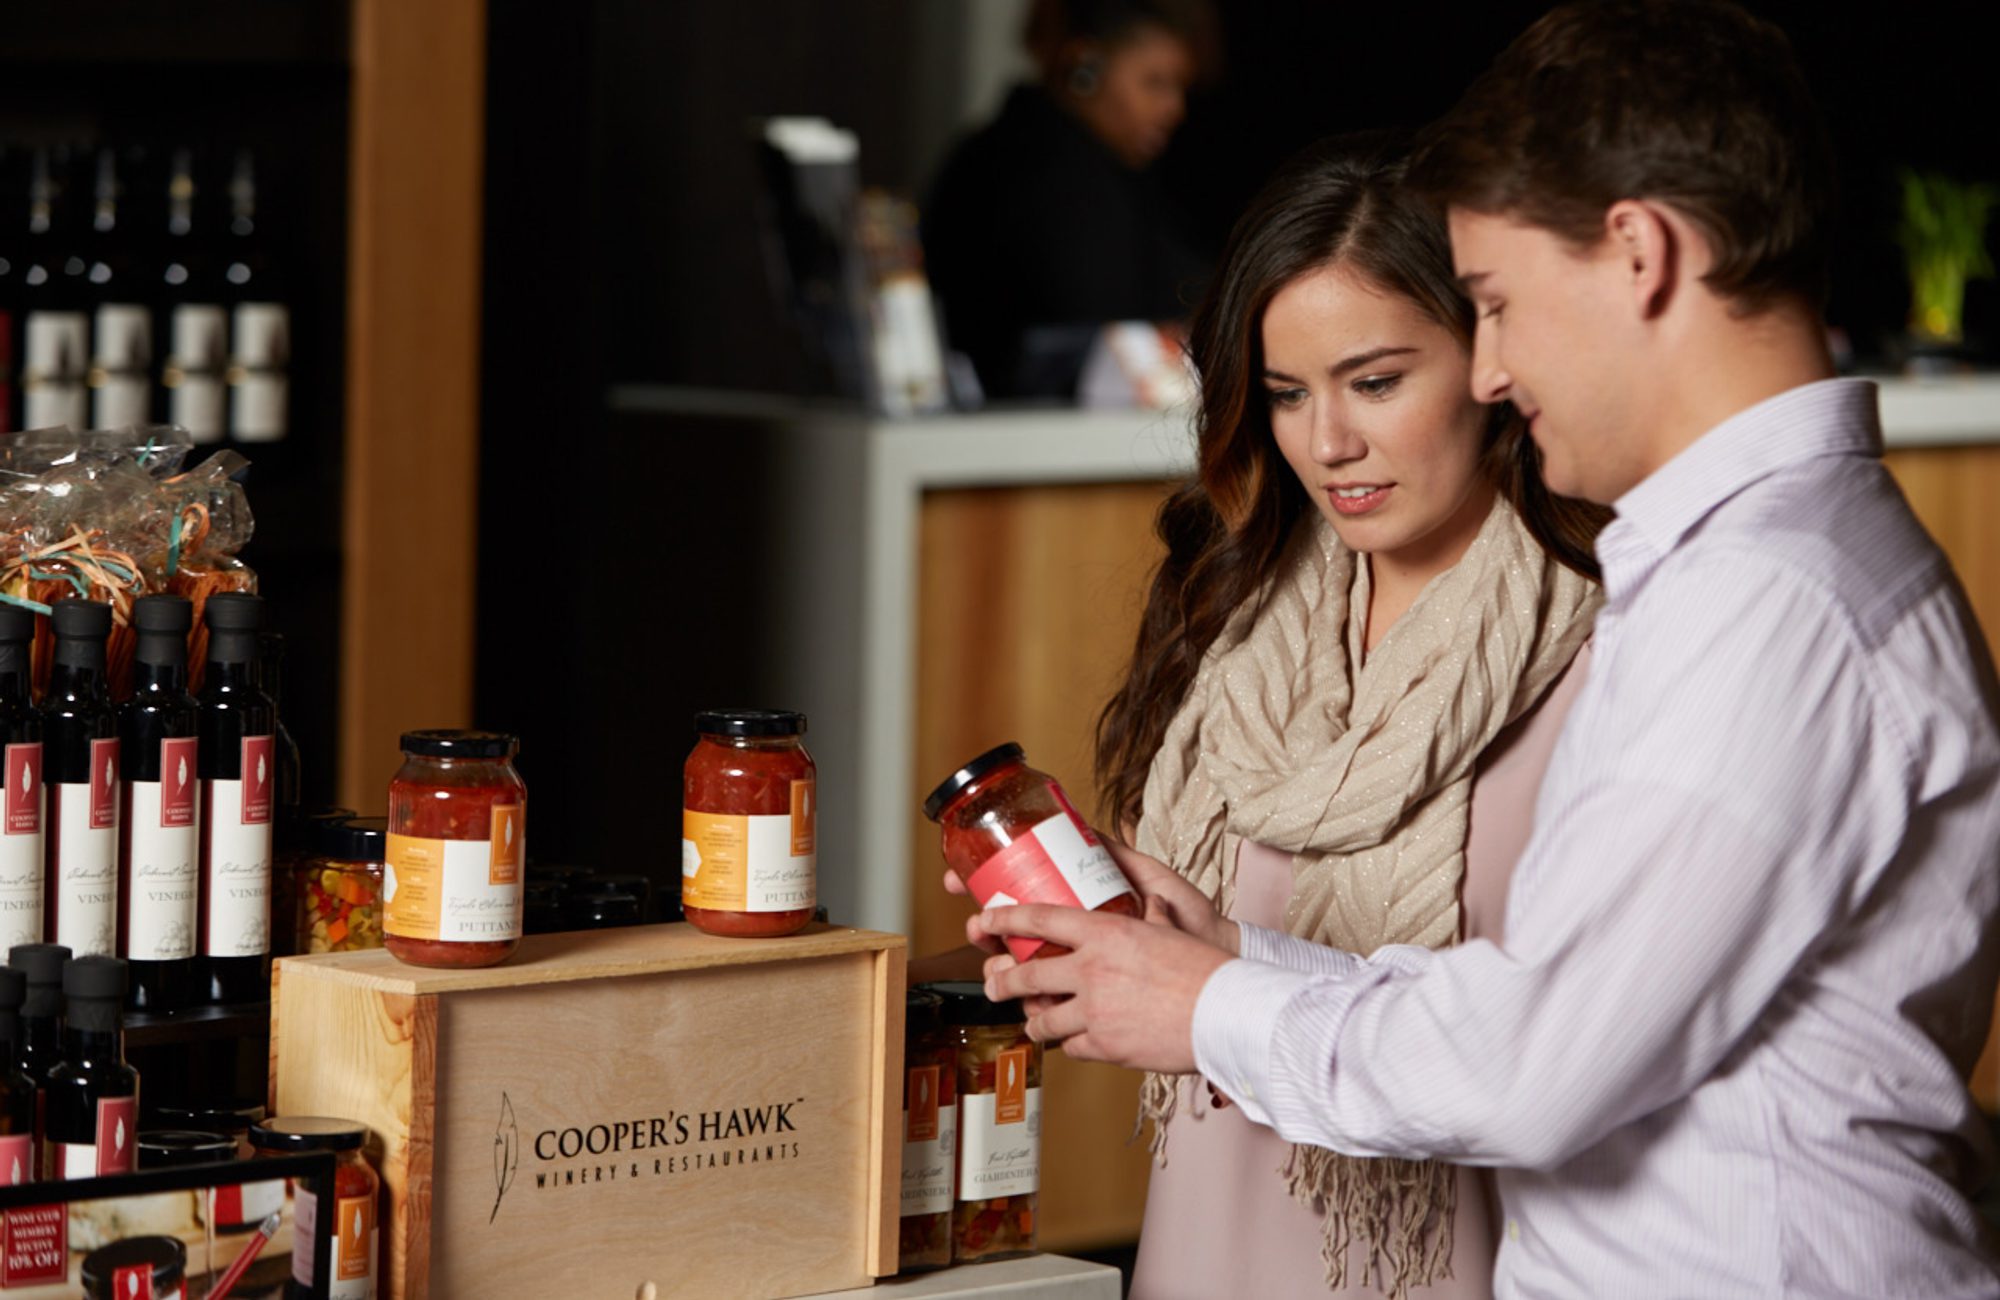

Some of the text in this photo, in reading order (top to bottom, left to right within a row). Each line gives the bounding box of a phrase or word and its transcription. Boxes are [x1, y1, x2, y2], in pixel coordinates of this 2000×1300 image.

[459, 919, 516, 932] PUTTAN
[535, 1103, 797, 1161] COOPER'S HAWK
[536, 1142, 799, 1189] WINERY & RESTAURANTS
[900, 1185, 951, 1199] ARDINIERA
[13, 1224, 57, 1239] MEMBERS
